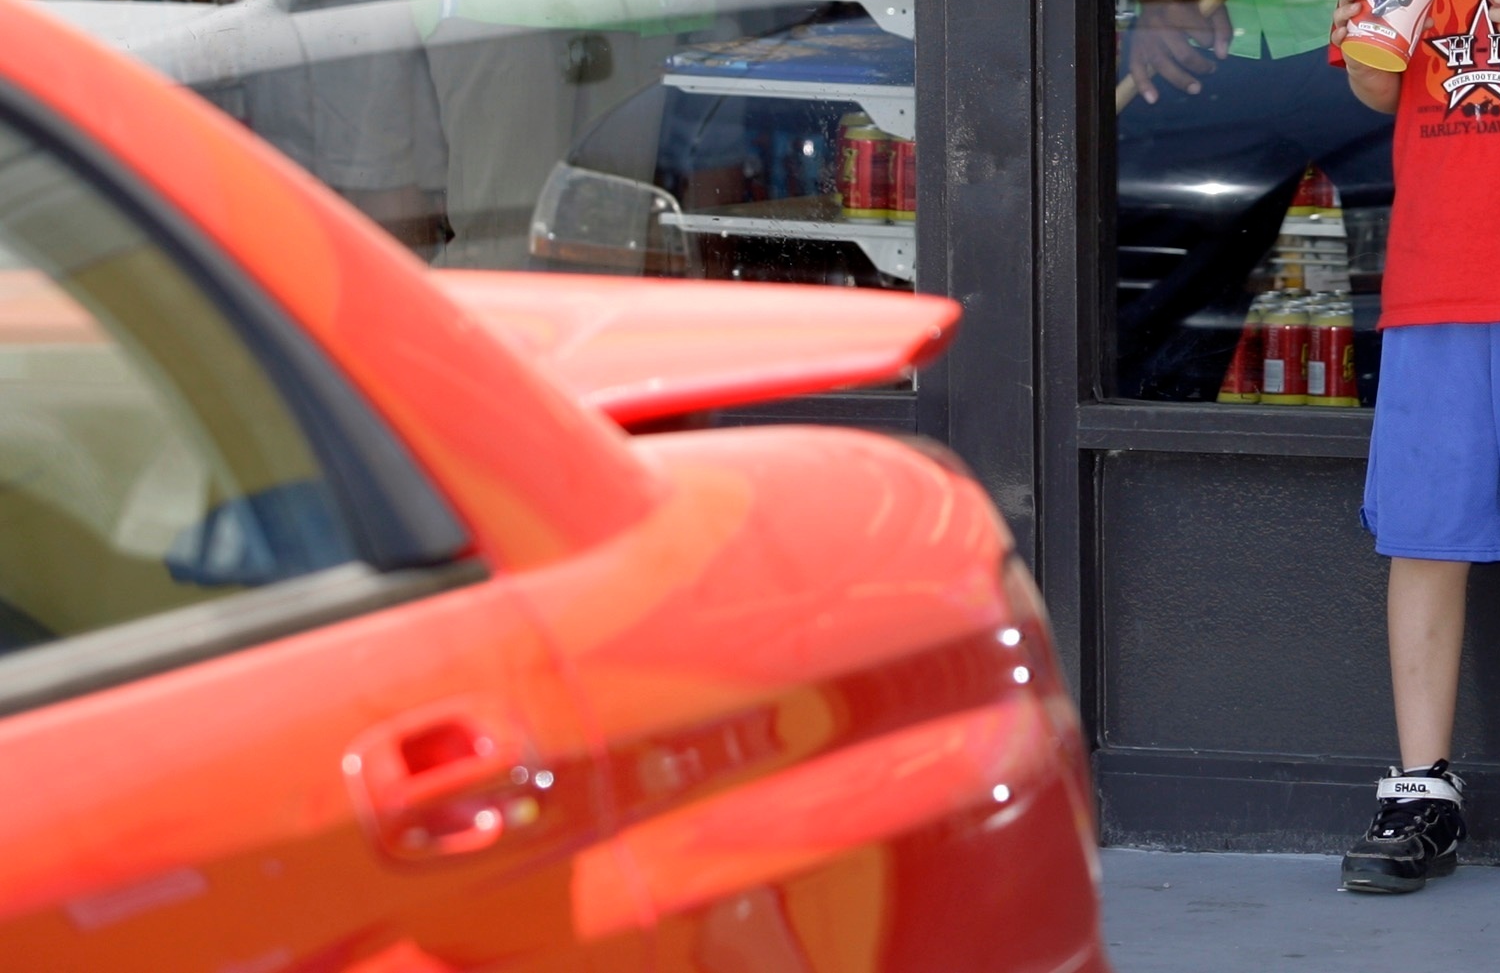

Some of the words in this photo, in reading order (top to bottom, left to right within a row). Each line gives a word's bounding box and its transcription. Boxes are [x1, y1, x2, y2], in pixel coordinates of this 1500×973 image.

[1451, 73, 1471, 88] OVER
[1472, 73, 1486, 81] 100
[1395, 783, 1430, 794] SHAQ
